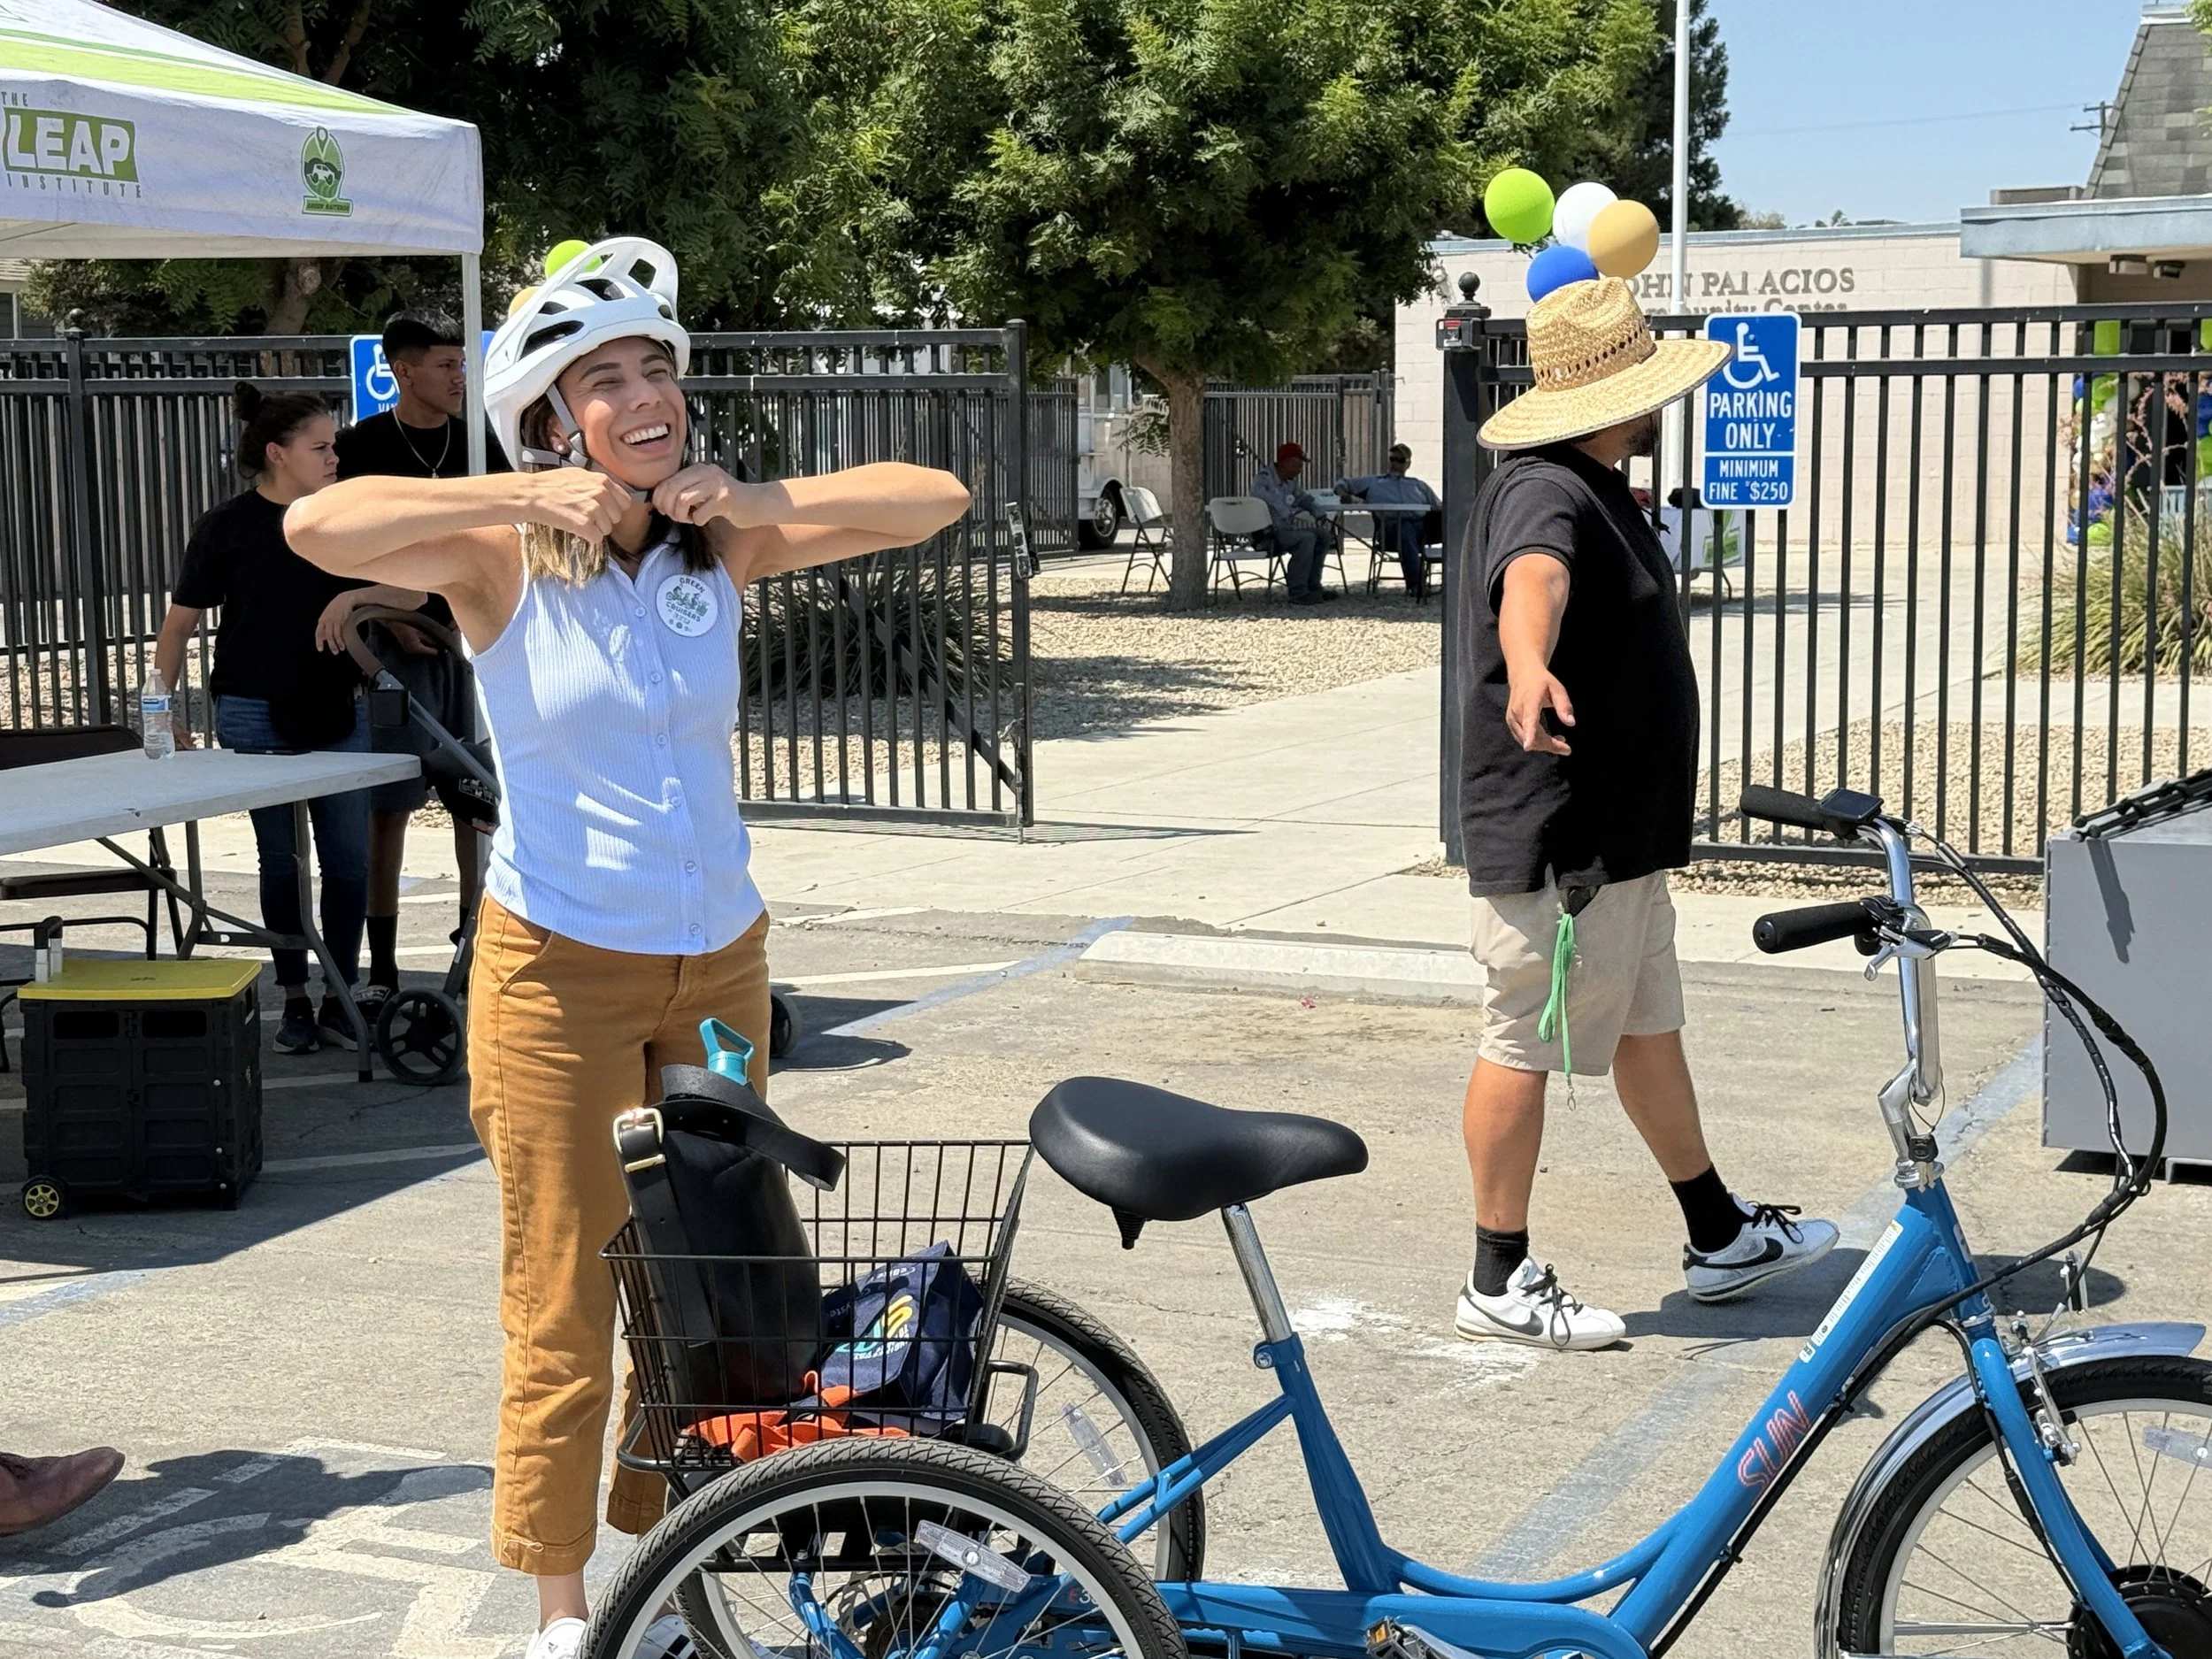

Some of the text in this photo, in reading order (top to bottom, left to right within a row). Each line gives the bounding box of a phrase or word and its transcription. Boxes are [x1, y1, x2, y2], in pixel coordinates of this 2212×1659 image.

[1, 91, 28, 107] THE
[7, 114, 131, 176] LEAP
[6, 173, 142, 198] INSTITUTE
[1632, 273, 1694, 298] HN
[1709, 389, 1793, 419] PARKING
[1724, 422, 1776, 449] ONLY
[1719, 459, 1778, 478] MINIMUM
[1709, 480, 1788, 502] FINE $250
[679, 577, 706, 594] GREEN
[1738, 1390, 1811, 1487] SUN
